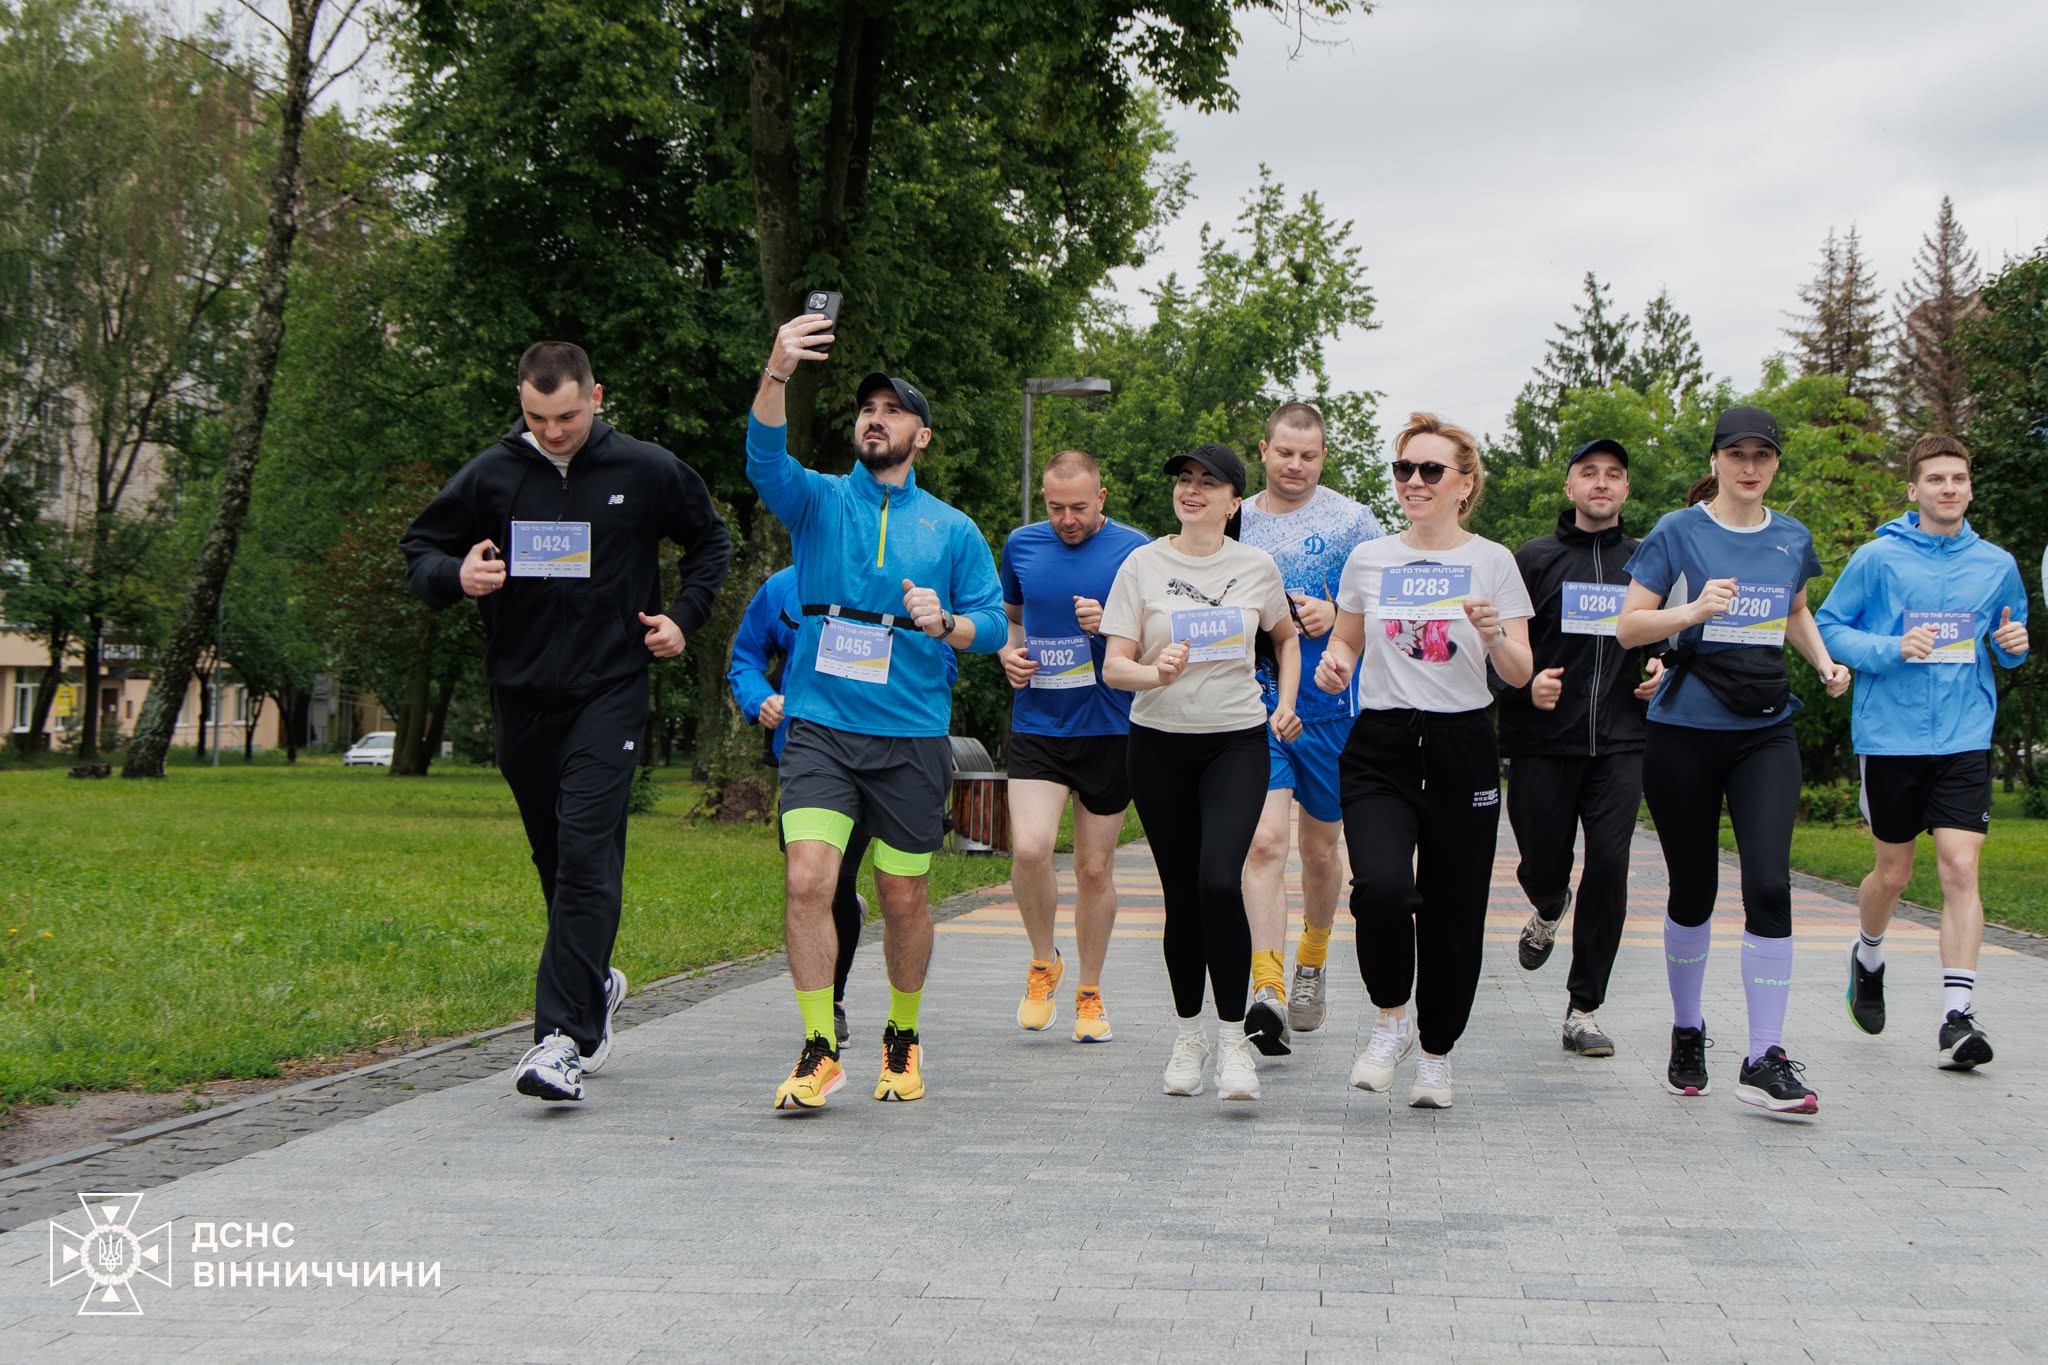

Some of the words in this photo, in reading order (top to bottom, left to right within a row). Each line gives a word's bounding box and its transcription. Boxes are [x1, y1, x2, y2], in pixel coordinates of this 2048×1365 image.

[532, 535, 571, 552] 0424
[1402, 577, 1450, 596] 0283
[1579, 594, 1617, 613] 0284
[1728, 596, 1772, 617] 0280
[1189, 619, 1228, 638] 0444
[835, 635, 872, 657] 0455
[1057, 638, 1084, 646] FUTURE
[1040, 648, 1075, 666] 0282
